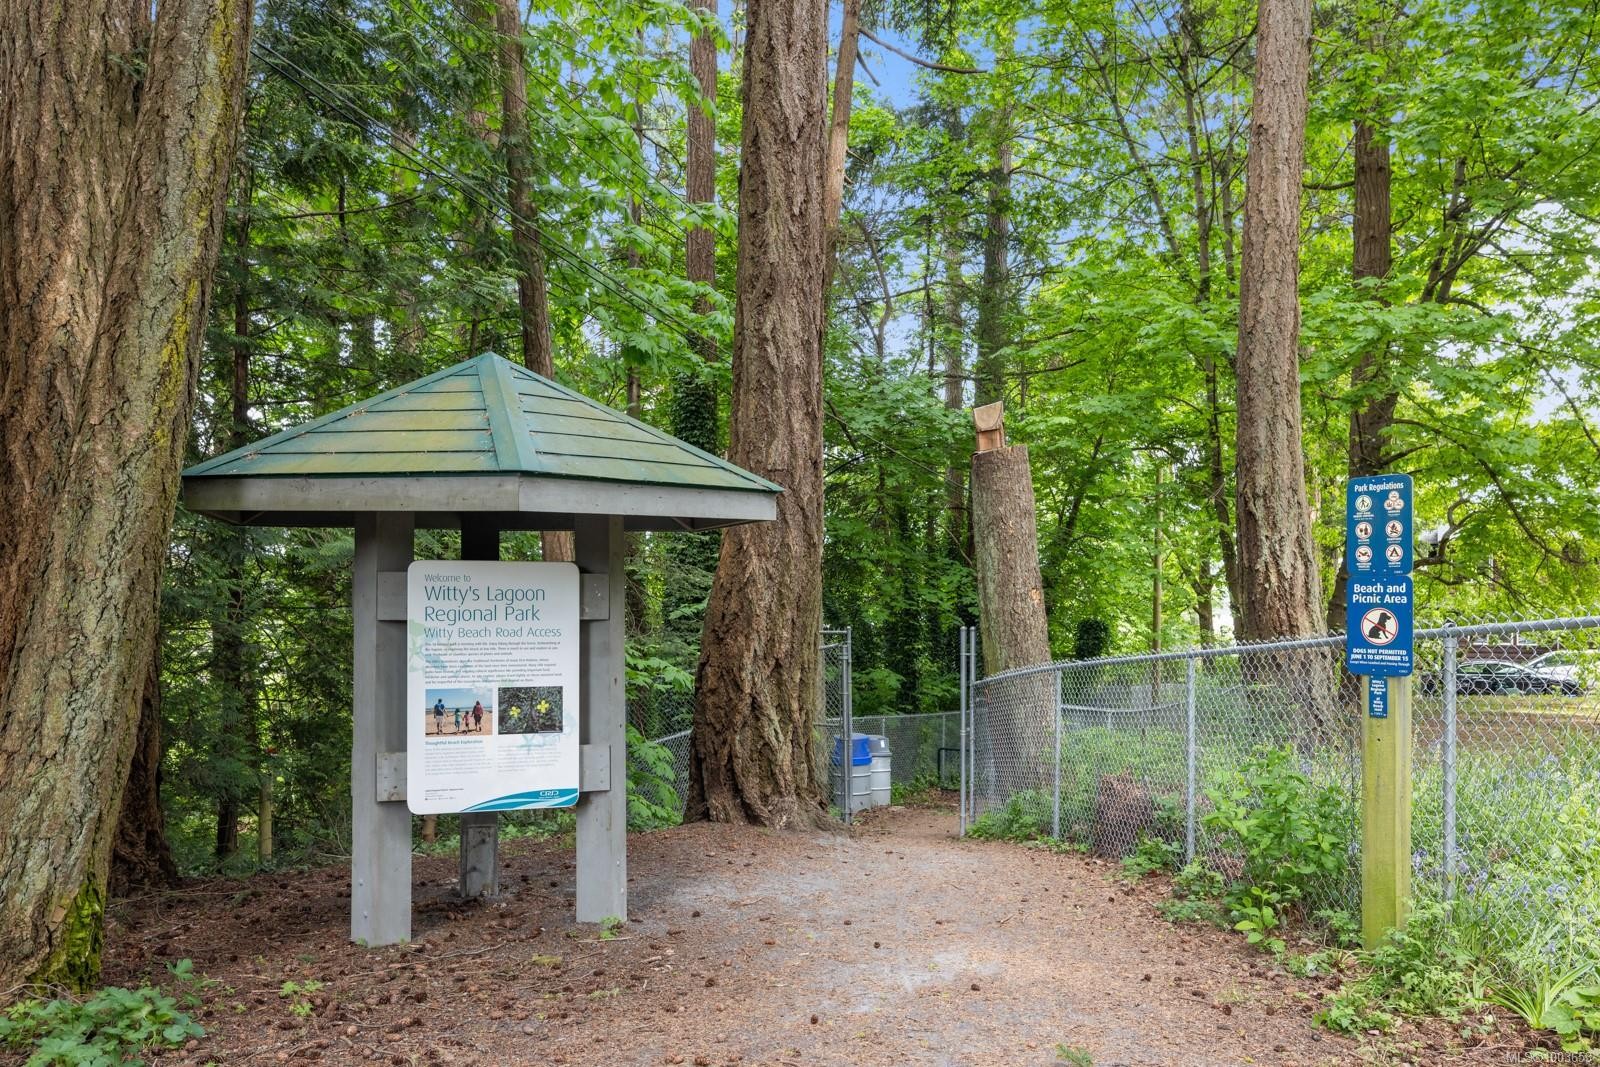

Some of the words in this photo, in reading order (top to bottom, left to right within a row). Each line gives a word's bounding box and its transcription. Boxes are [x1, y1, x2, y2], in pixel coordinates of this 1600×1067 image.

[1354, 484, 1368, 492] Park
[1369, 482, 1404, 492] Regulations
[425, 574, 460, 582] Welcome
[464, 574, 471, 582] to
[1354, 583, 1383, 592] Beach
[1387, 583, 1406, 592] and
[424, 586, 480, 605] Witty's
[487, 586, 545, 605] Lagoon
[1353, 594, 1381, 603] Picnic
[1384, 594, 1407, 603] Area
[424, 605, 497, 626] Regional
[505, 605, 541, 621] Park
[424, 627, 453, 640] Witty
[458, 627, 491, 637] Beach
[496, 627, 523, 637] Road
[527, 627, 561, 637] Access
